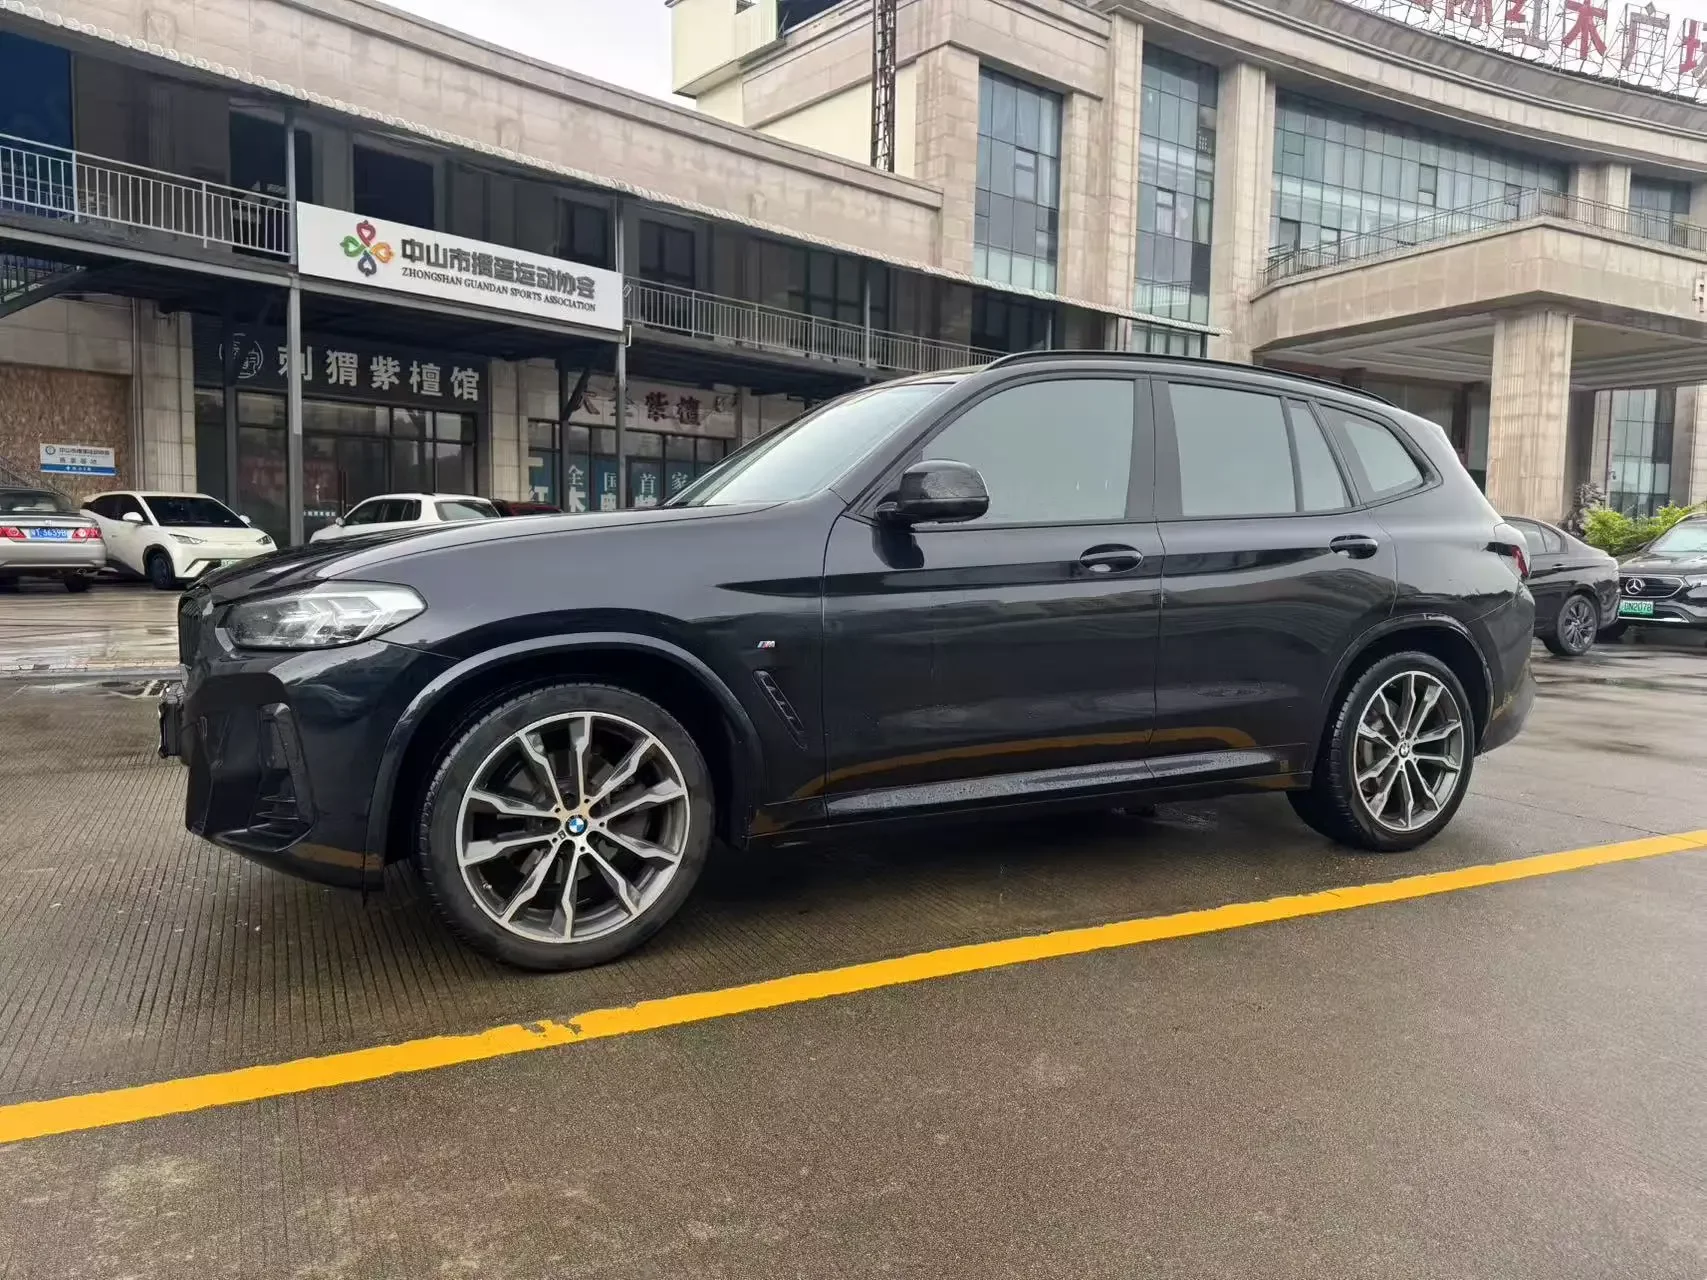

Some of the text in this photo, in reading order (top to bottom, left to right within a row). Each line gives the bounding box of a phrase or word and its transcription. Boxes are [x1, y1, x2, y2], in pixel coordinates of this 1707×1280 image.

[402, 267, 596, 312] ZHONGSHAN GUANDAN SPORTS ASSOCIATION
